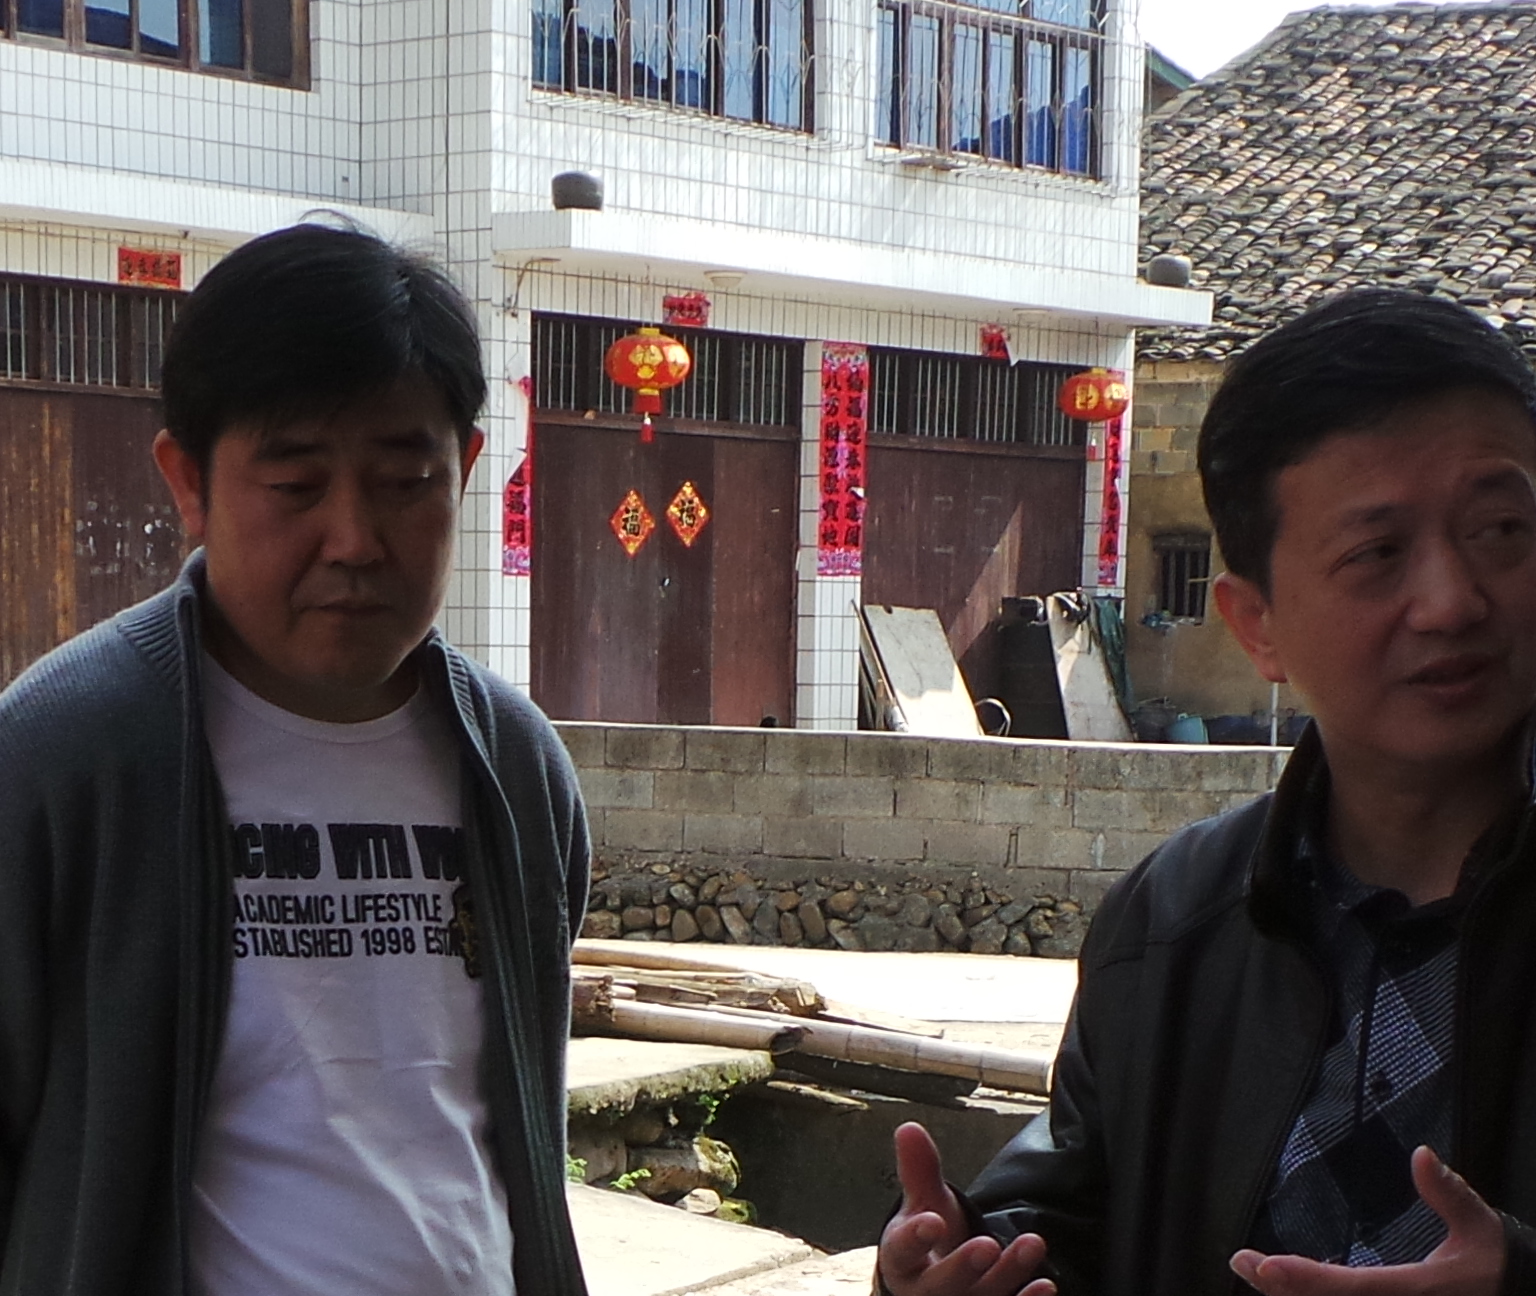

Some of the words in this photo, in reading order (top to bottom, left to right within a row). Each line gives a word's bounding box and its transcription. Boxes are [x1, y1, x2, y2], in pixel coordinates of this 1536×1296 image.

[231, 823, 321, 879] CING
[234, 894, 335, 924] ACADEMIC
[342, 893, 442, 924] LIFESTYLE
[233, 927, 353, 958] STABLISHED
[360, 927, 416, 957] 1998
